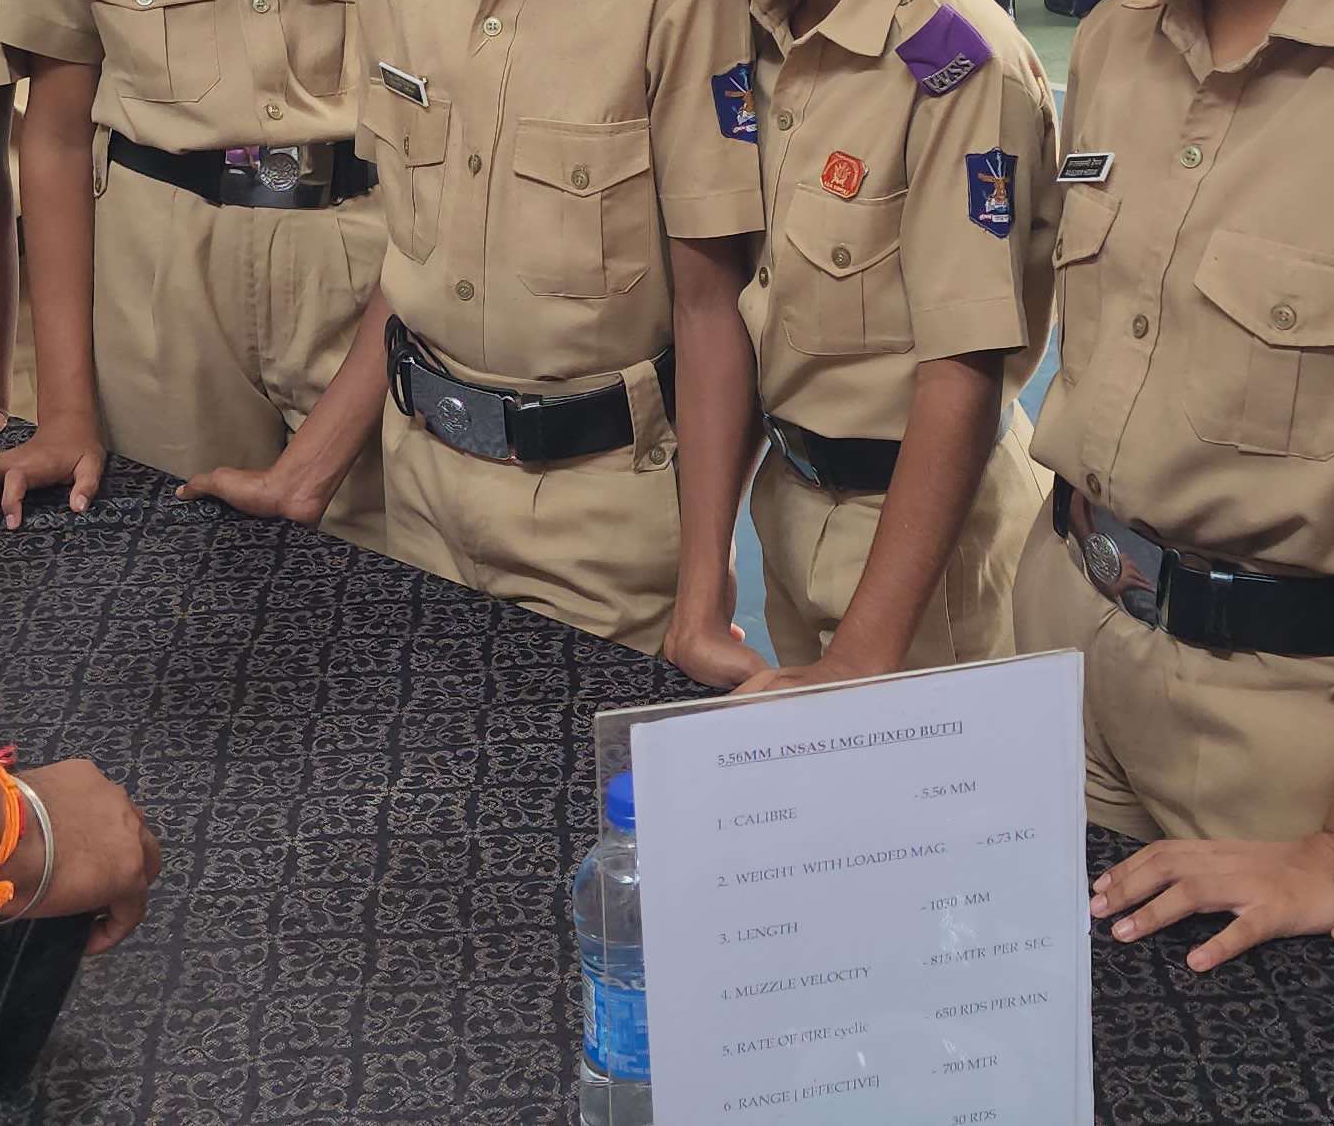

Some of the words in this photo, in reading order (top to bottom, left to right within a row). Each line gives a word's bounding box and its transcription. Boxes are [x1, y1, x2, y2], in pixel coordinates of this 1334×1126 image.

[922, 52, 976, 94] VVSS
[717, 747, 772, 766] 5.56MM
[780, 740, 826, 757] INSAS
[830, 734, 865, 750] LMG
[734, 807, 798, 827] CALIBRE
[921, 786, 947, 800] 5.56
[950, 780, 977, 795] MM
[736, 865, 796, 885] WEIGHT
[802, 858, 842, 875] WITH
[846, 848, 908, 868] LOADED
[719, 933, 730, 945] 3.
[738, 922, 798, 942] LENGTH
[964, 891, 991, 906] MM
[721, 990, 732, 1000] 4.
[735, 978, 797, 999] MUZZLE
[800, 966, 871, 987] VELOCITY
[930, 953, 952, 966] 815
[956, 947, 987, 961] MTR
[993, 942, 1019, 956] PER
[722, 1045, 733, 1057] 5.
[736, 1037, 775, 1054] RATE
[778, 1033, 797, 1047] OF
[801, 1027, 832, 1043] FIRE
[834, 1022, 870, 1040] cyclic
[935, 1006, 957, 1020] 650
[960, 1001, 988, 1016] RDS
[991, 996, 1016, 1011] PER
[739, 1090, 790, 1110] RANGE
[943, 1061, 964, 1075] 700
[967, 1055, 998, 1070] MTR
[970, 1109, 997, 1123] RDS
